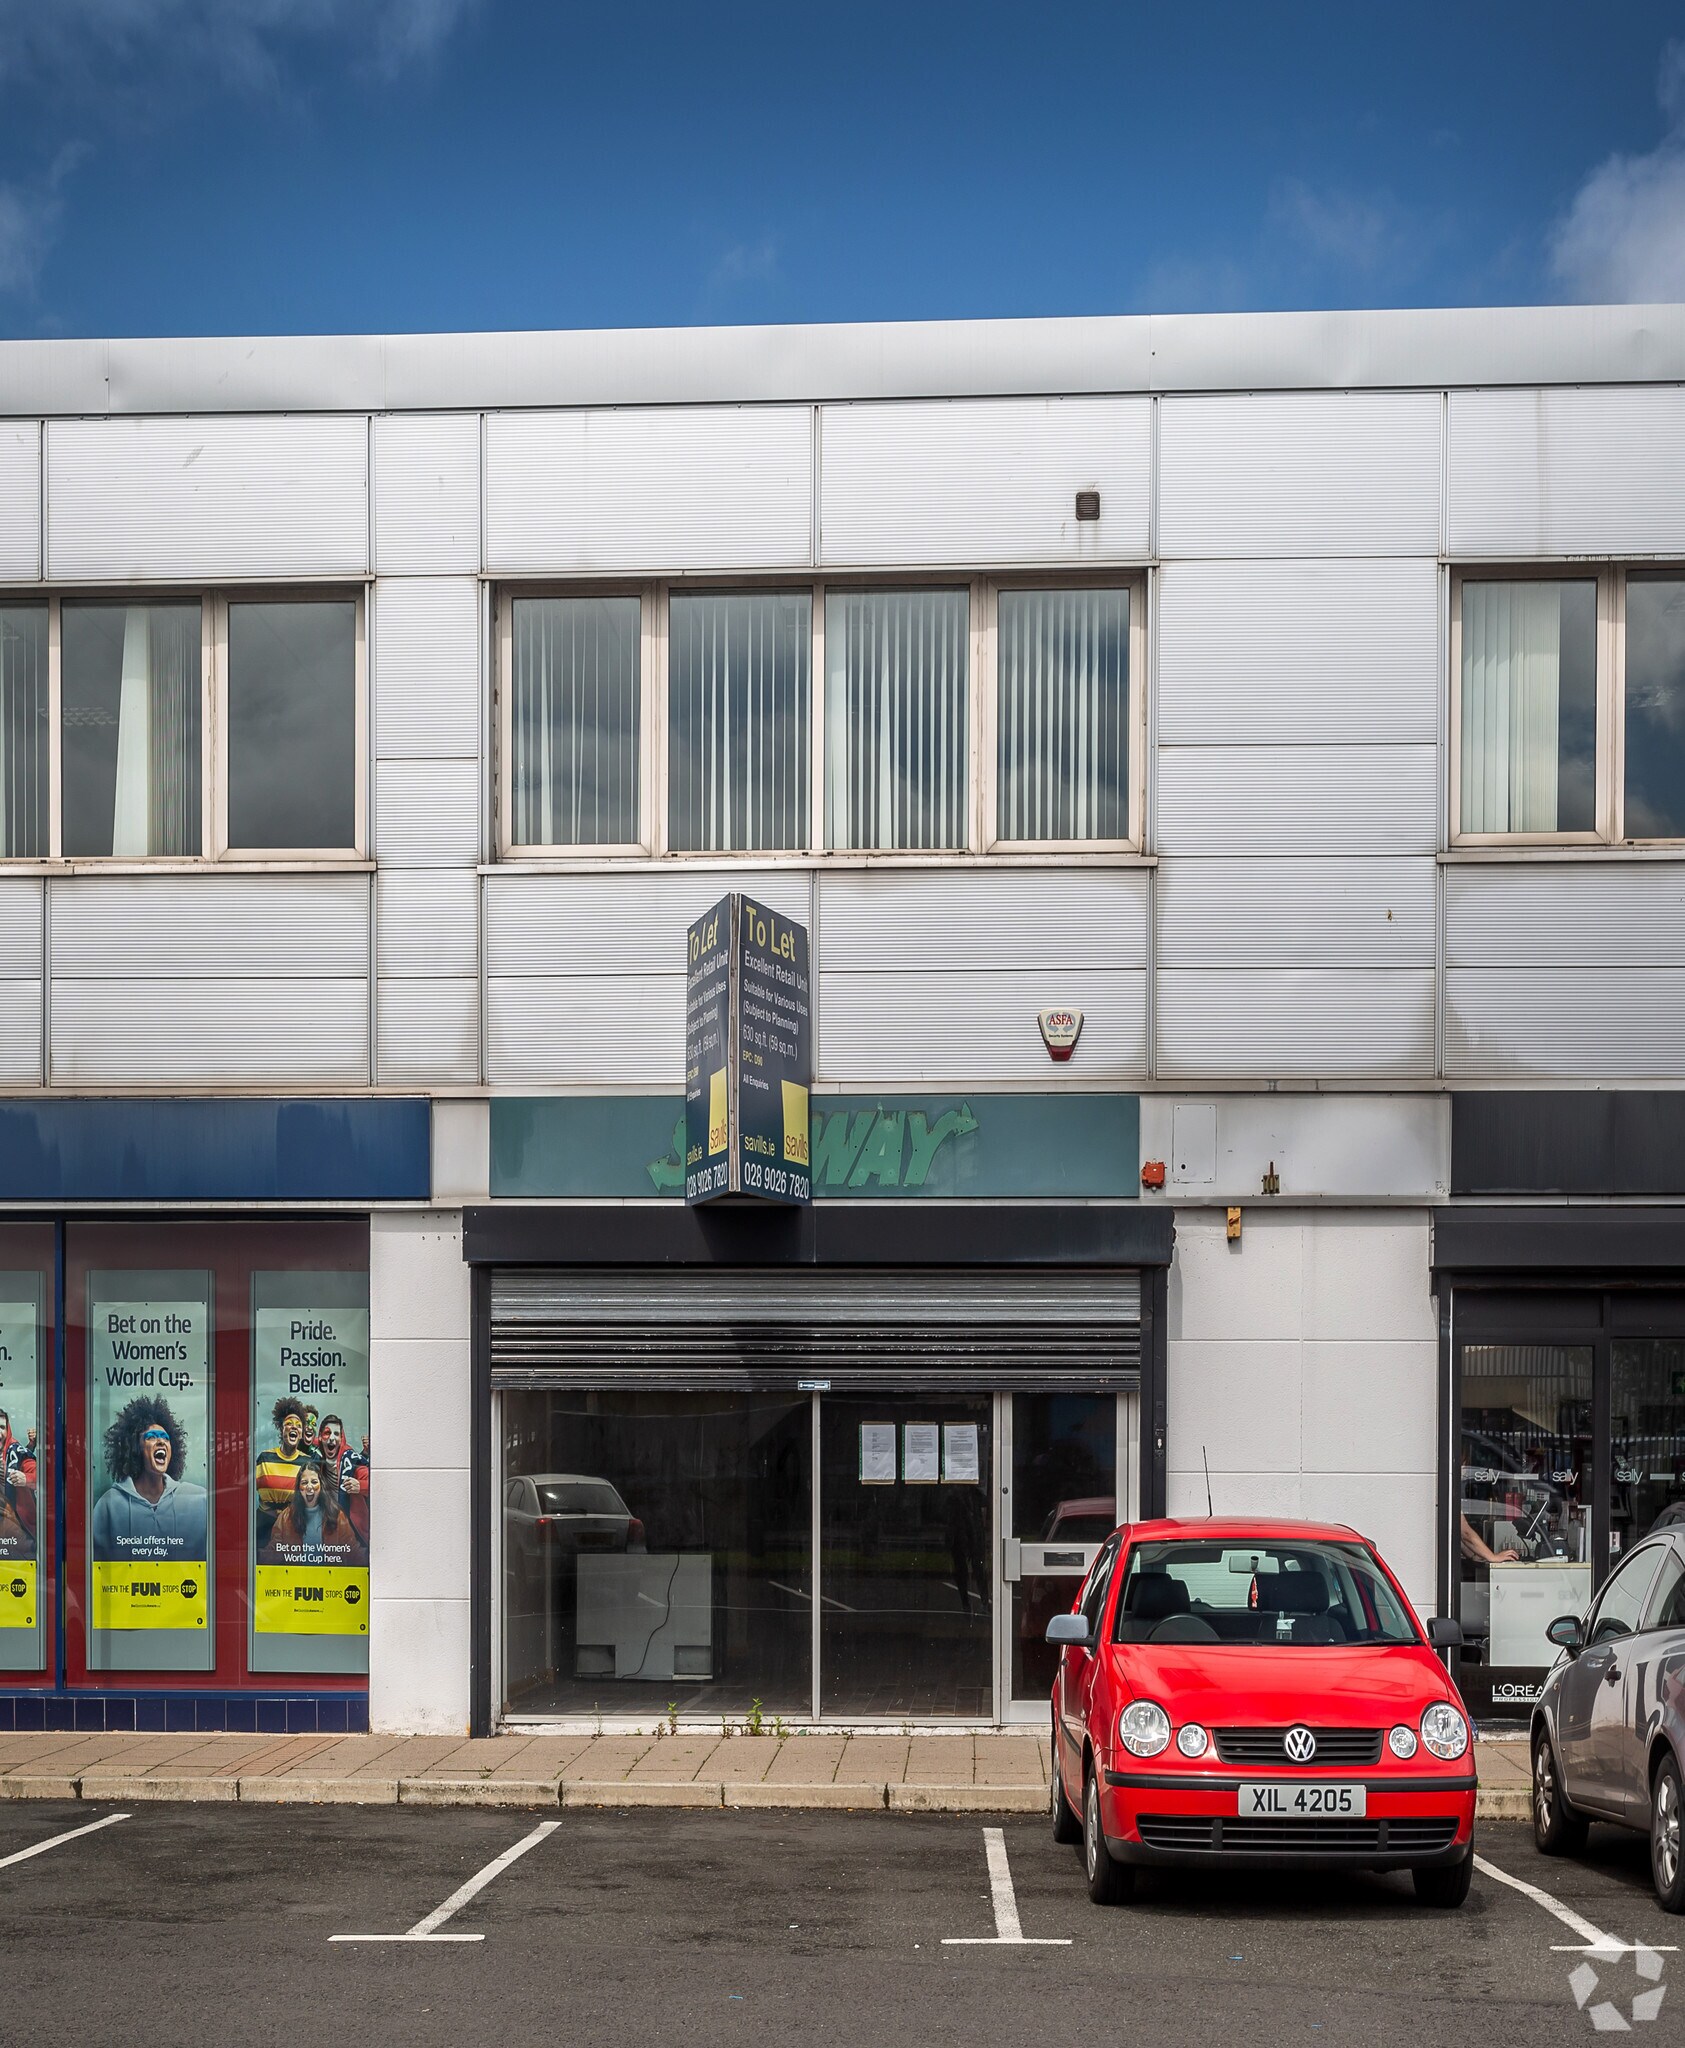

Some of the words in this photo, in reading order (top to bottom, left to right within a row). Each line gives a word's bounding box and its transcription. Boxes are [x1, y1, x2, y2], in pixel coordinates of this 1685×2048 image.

[689, 931, 699, 965] To
[701, 912, 719, 955] Let
[746, 905, 766, 947] To
[771, 918, 796, 962] Let
[744, 949, 774, 978] Excellent
[776, 964, 795, 987] Retail
[743, 978, 766, 999] Suitable
[774, 992, 796, 1011] Various
[743, 999, 766, 1020] (Subject
[766, 1009, 772, 1022] to
[772, 1011, 799, 1036] Planning)
[1049, 1014, 1073, 1025] ASFA
[743, 1024, 754, 1042] 630
[645, 1101, 980, 1195] SWAY
[744, 1135, 776, 1156] savills.ie
[785, 1133, 808, 1160] savills
[686, 1174, 697, 1199] 028
[697, 1167, 713, 1195] 9026
[713, 1161, 728, 1189] 7820
[744, 1161, 762, 1188] 028
[764, 1166, 787, 1194] 9026
[789, 1173, 810, 1200] 7820
[108, 1314, 136, 1334] Bet
[140, 1318, 160, 1334] on
[164, 1313, 192, 1334] the
[291, 1320, 337, 1340] Pride.
[112, 1340, 187, 1360] Women's
[281, 1346, 347, 1367] Passion.
[105, 1366, 154, 1386] World
[158, 1366, 194, 1391] Cup.
[289, 1373, 338, 1394] Belief.
[1474, 1468, 1501, 1485] sally
[1552, 1468, 1579, 1485] sally
[1616, 1468, 1643, 1485] sally
[116, 1535, 143, 1546] Special
[143, 1535, 166, 1546] offers
[166, 1536, 184, 1545] here
[276, 1543, 290, 1552] Bet
[302, 1543, 315, 1552] the
[316, 1543, 351, 1553] Women's
[131, 1547, 153, 1557] every
[153, 1546, 169, 1557] day.
[284, 1553, 307, 1562] World
[307, 1553, 323, 1564] Cup
[323, 1554, 343, 1563] here.
[11, 1584, 26, 1592] STOP
[102, 1585, 119, 1593] WHEN
[119, 1585, 130, 1593] THE
[131, 1582, 161, 1596] FUN
[162, 1585, 180, 1593] STOPS
[181, 1585, 197, 1593] STOP
[265, 1589, 281, 1597] WHEN
[294, 1586, 324, 1601] FUN
[325, 1590, 343, 1598] STOPS
[1492, 1683, 1543, 1697] L'ORÉA
[1252, 1788, 1287, 1812] XIL
[1294, 1788, 1352, 1812] 4205
